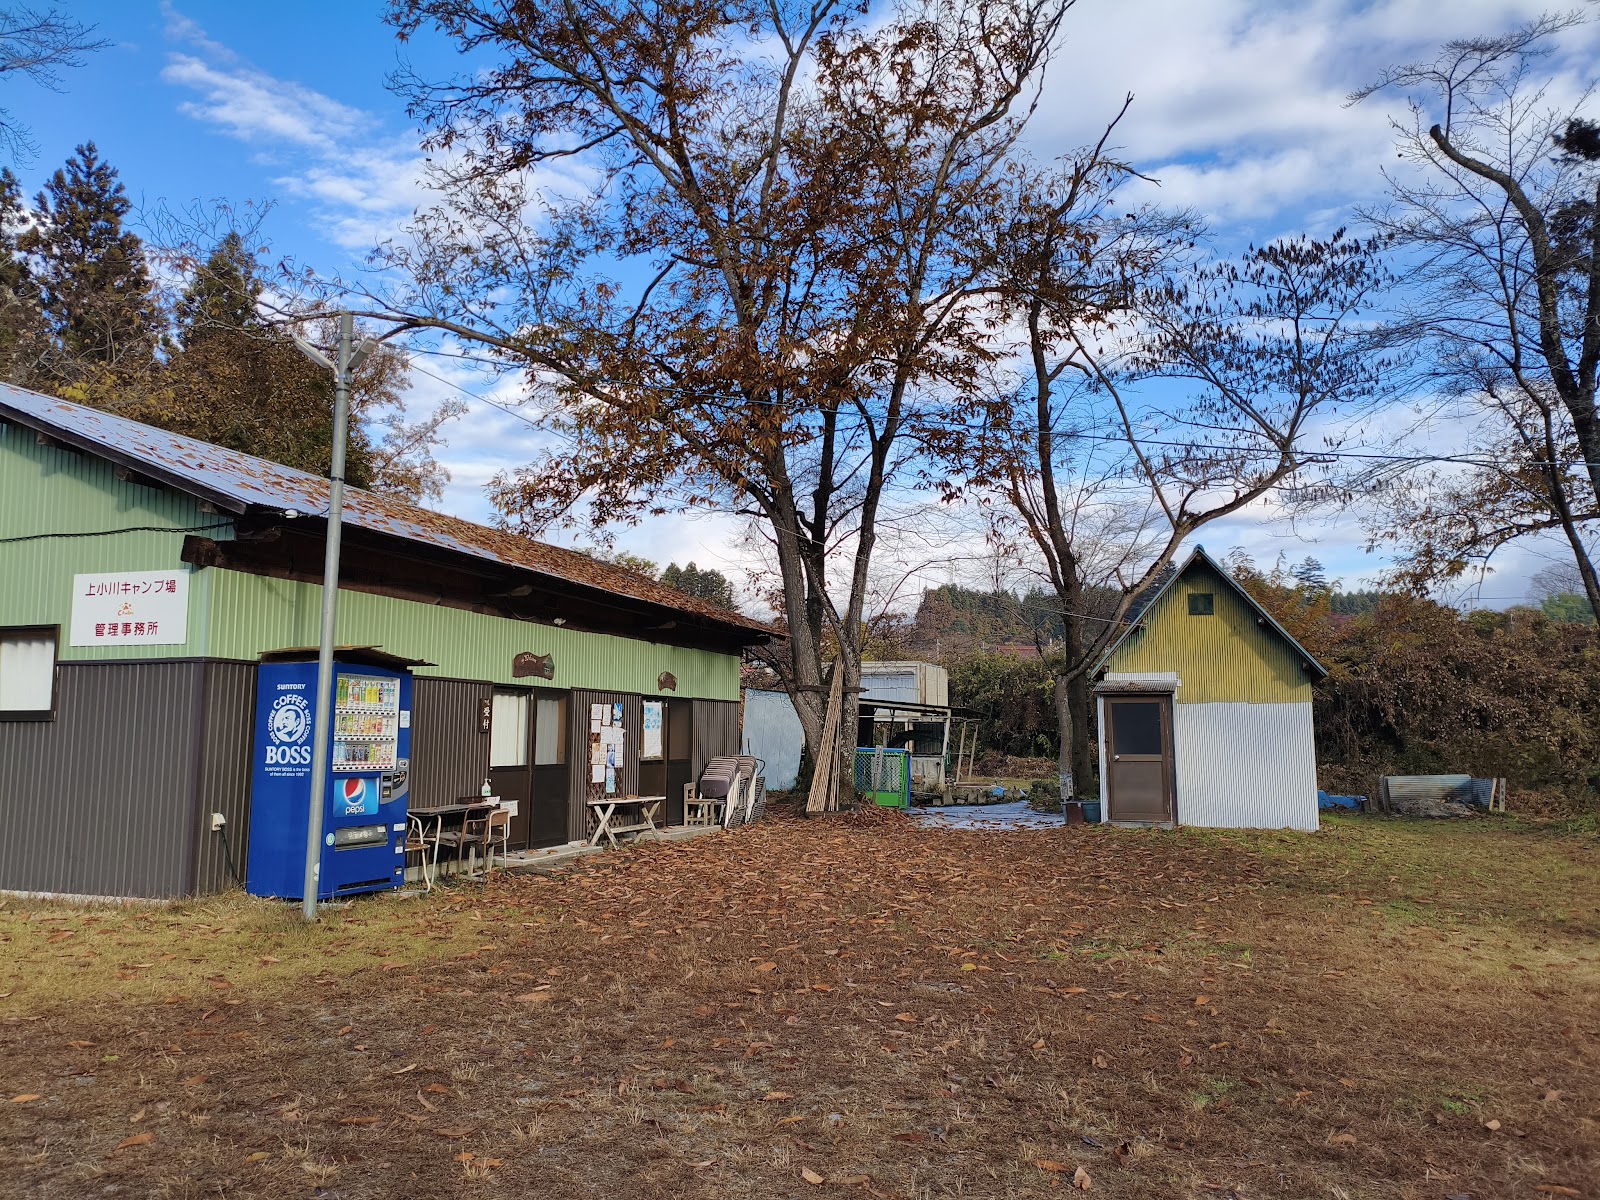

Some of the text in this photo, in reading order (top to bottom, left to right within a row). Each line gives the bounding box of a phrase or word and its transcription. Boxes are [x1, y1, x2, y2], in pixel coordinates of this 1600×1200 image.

[85, 580, 176, 596] 上小川キャンプ場
[95, 621, 158, 637] 管理事務所
[273, 694, 308, 709] COFFEE
[265, 746, 311, 764] BOSS
[345, 804, 365, 816] pepsi
